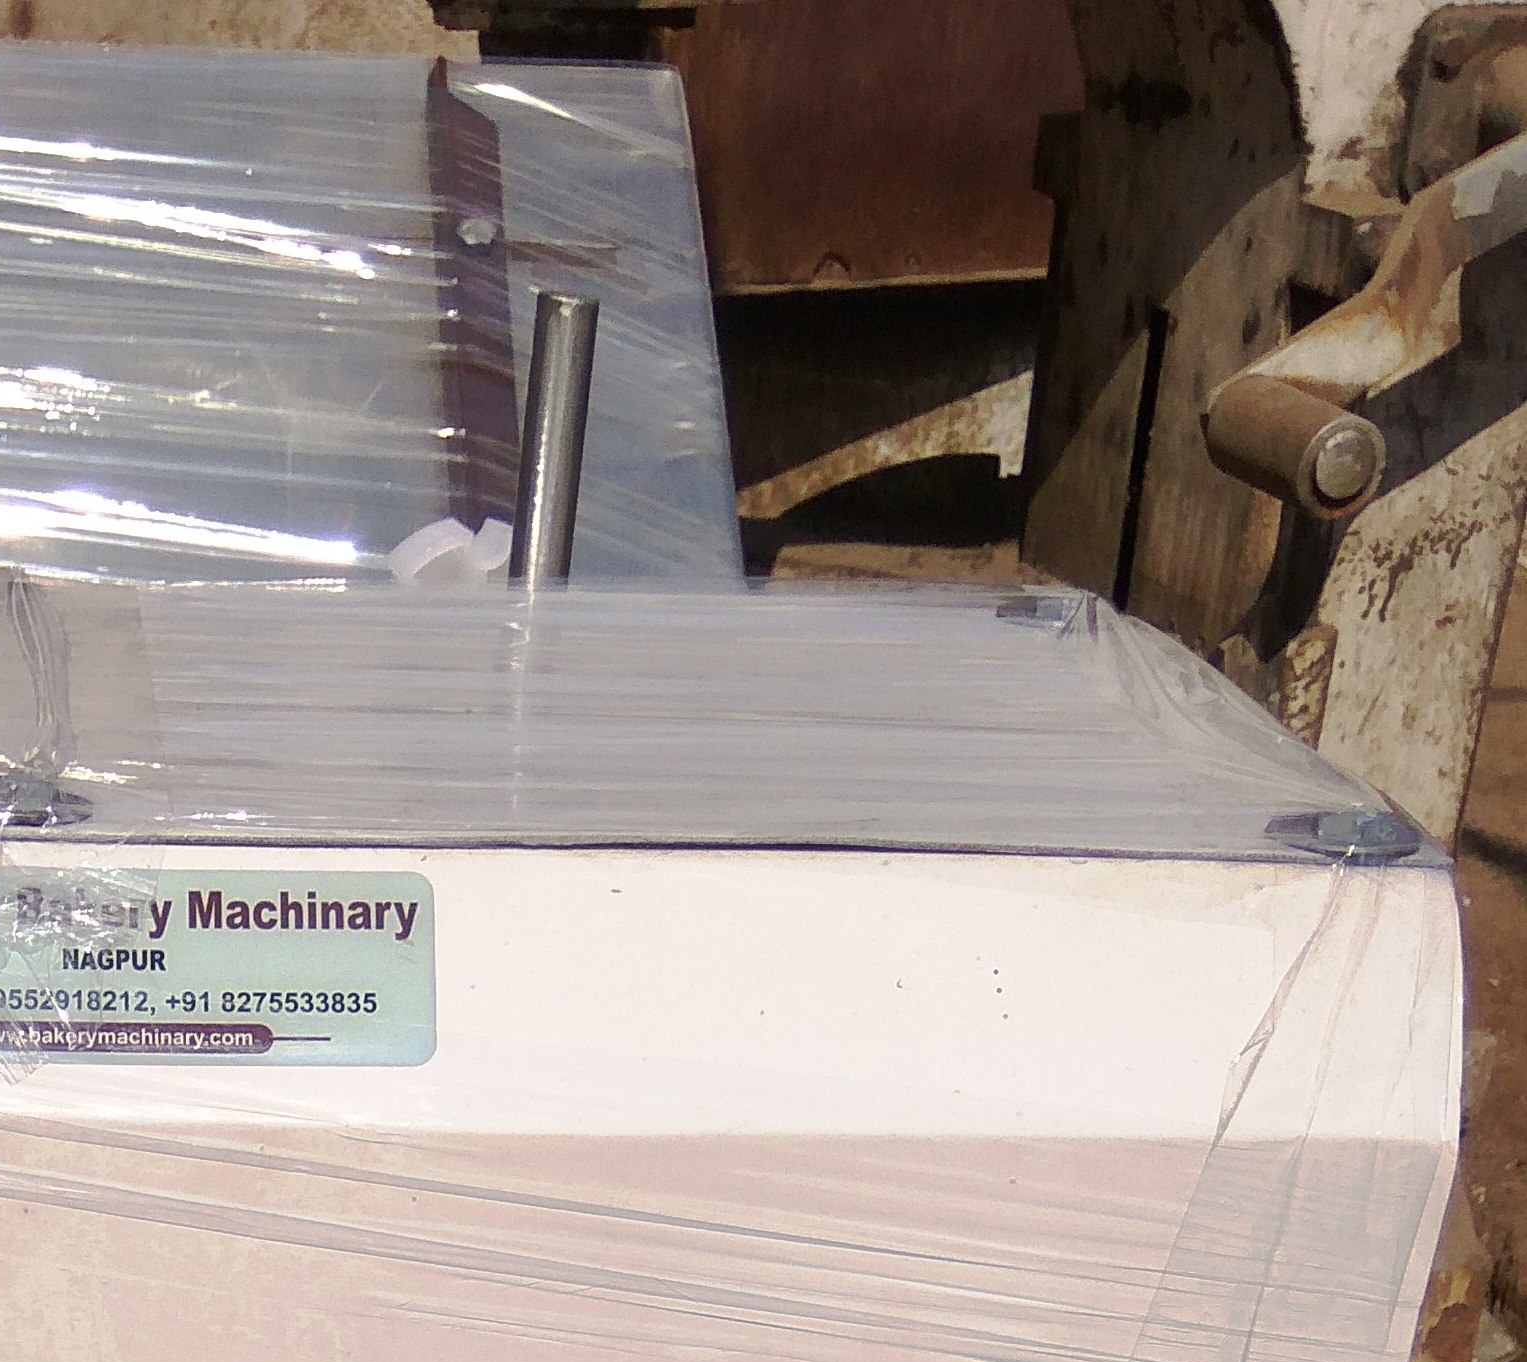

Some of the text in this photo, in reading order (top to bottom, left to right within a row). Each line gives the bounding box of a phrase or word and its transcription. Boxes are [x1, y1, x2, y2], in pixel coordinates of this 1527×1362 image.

[188, 890, 418, 941] Machinary
[62, 949, 166, 972] NAGPUR
[165, 991, 210, 1012] +91
[221, 992, 378, 1013] 8275533835
